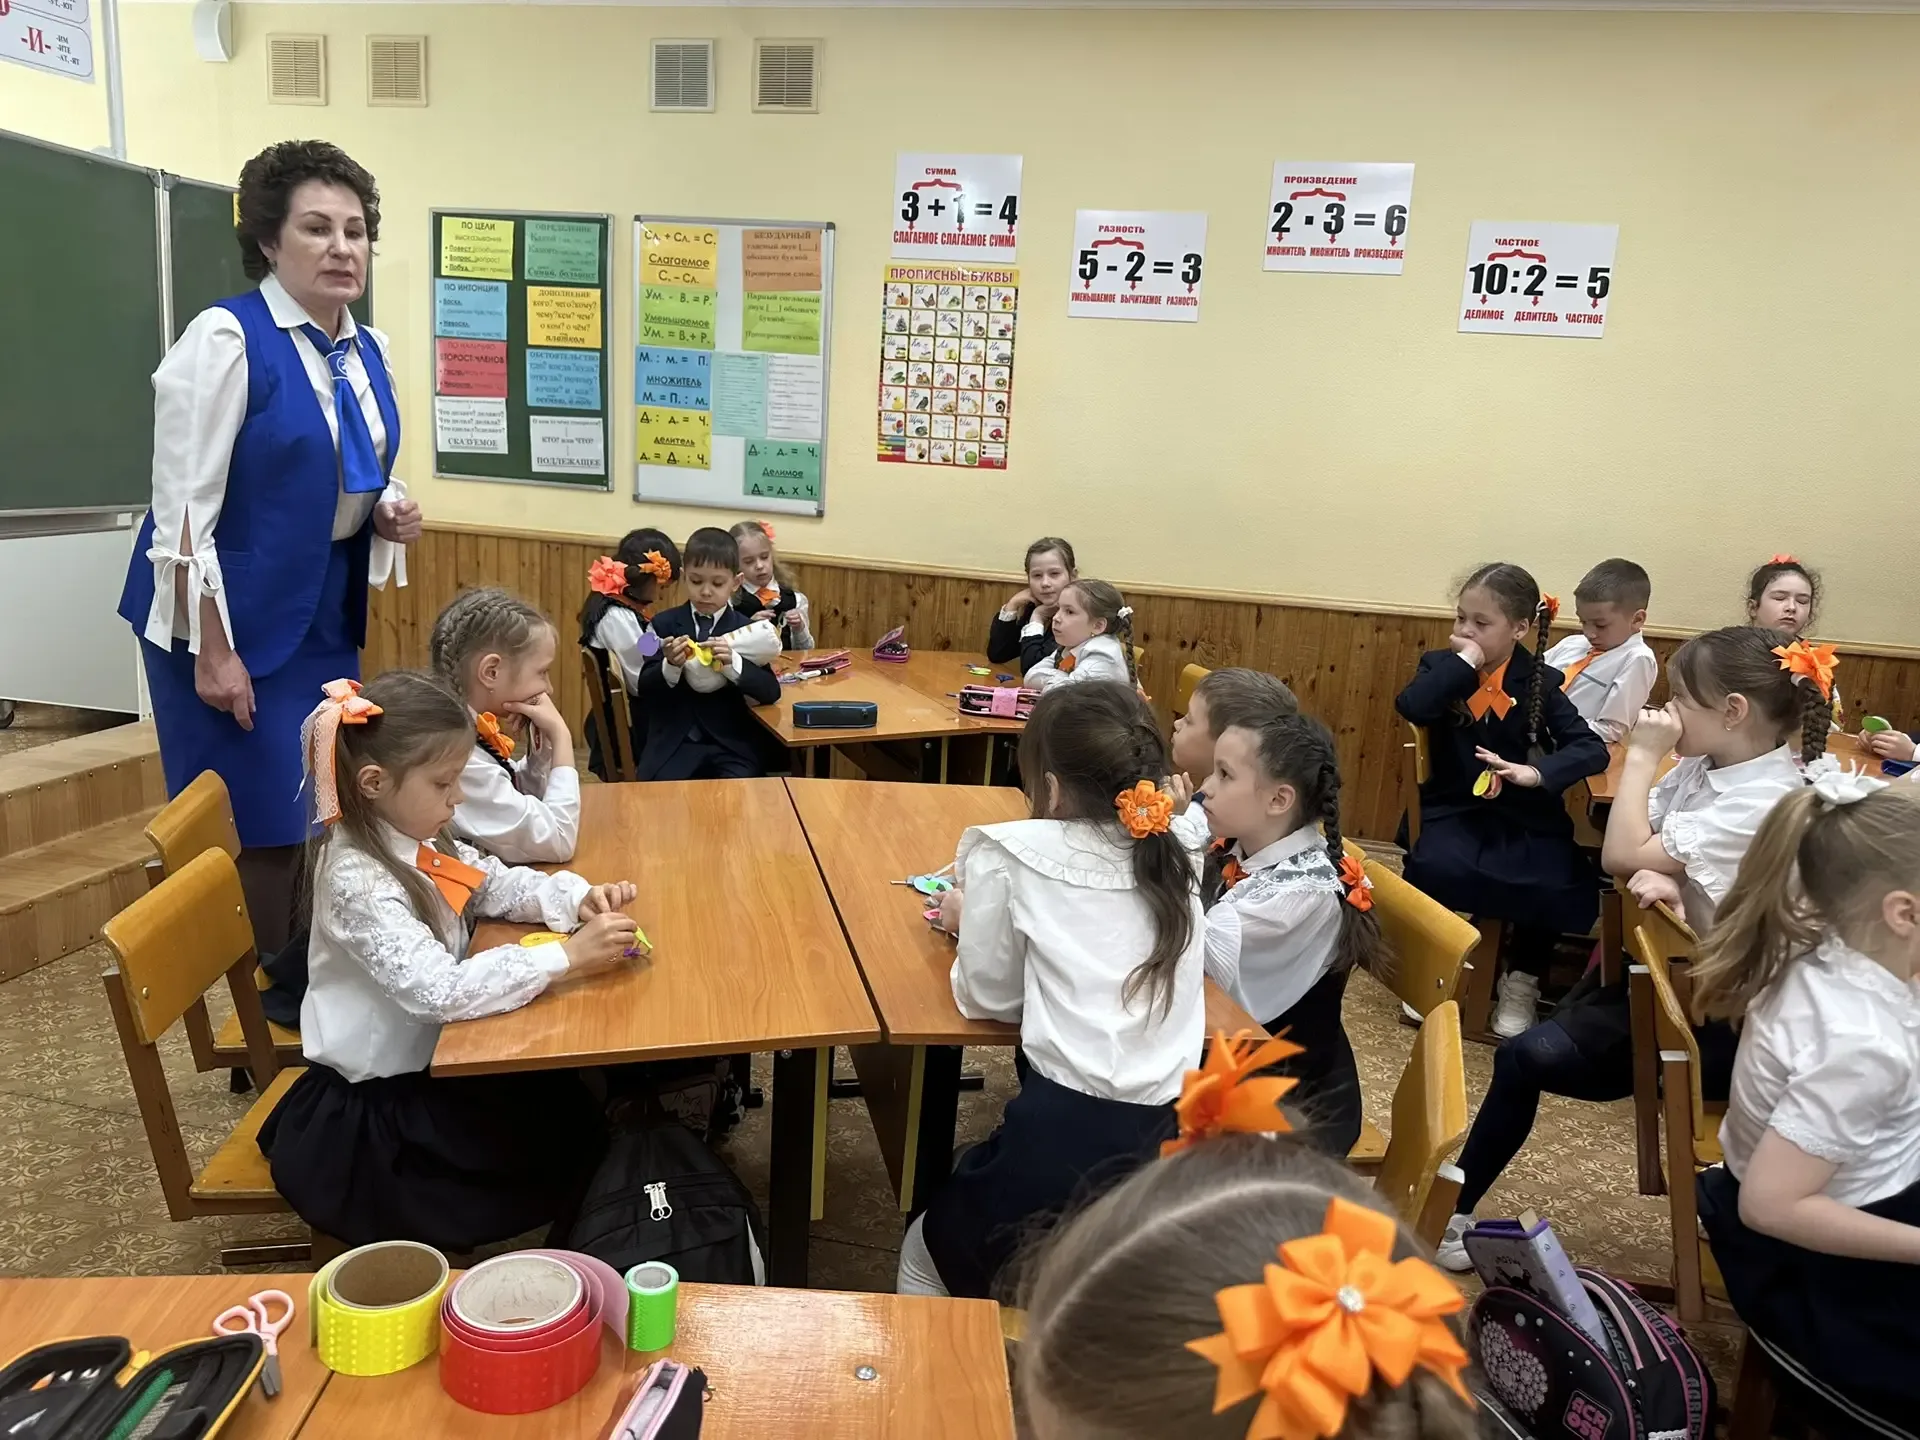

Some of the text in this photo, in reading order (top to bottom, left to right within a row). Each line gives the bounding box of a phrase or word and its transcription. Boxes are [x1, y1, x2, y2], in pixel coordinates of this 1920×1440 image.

[1284, 176, 1358, 185] ПРОИЗВЕДЕНИЕ
[902, 191, 919, 221] 3
[953, 194, 966, 223] 1
[999, 195, 1018, 225] 4
[461, 221, 496, 231] ПО ЦЕЛИ
[1271, 202, 1293, 232] 2
[1323, 203, 1345, 234] 3
[1384, 205, 1407, 236] 6
[754, 231, 811, 240] БЕЗУДАРНЫЙ
[1099, 225, 1145, 233] РАЗНОСТЬ
[893, 231, 1016, 247] СЛАГАЕМОЕ СЛАГАЕМОЕ СУММА
[1495, 238, 1540, 247] ЧАСТНОЕ
[1267, 246, 1404, 260] МНОЖИТЕЛЬ МНОЖИТЕЛЬ ПРОИЗВЕДЕНИЕ
[649, 253, 710, 268] Слагаемое
[1078, 249, 1099, 280] 5
[1125, 251, 1145, 281] 2
[1181, 253, 1202, 284] 3
[890, 268, 1013, 283] ПРОПИСНЫЕ БУКВЫ
[444, 283, 456, 291] ПО
[1587, 267, 1610, 299] 5
[1072, 292, 1198, 306] УМЕНЬШАЕМОЕ ВЫЧИТАЕМОЕ РАЗНОСТЬ
[645, 313, 710, 327] Уменьшаемое
[1464, 309, 1603, 324] ДЕЛИМОЕ ДЕЛИТЕЛЬ ЧАСТНОЕ
[646, 376, 702, 387] МНОЖИТЕЛЬ
[537, 457, 601, 467] ПОДЛЕЖАЩЕЕ
[762, 467, 804, 478] Делимое
